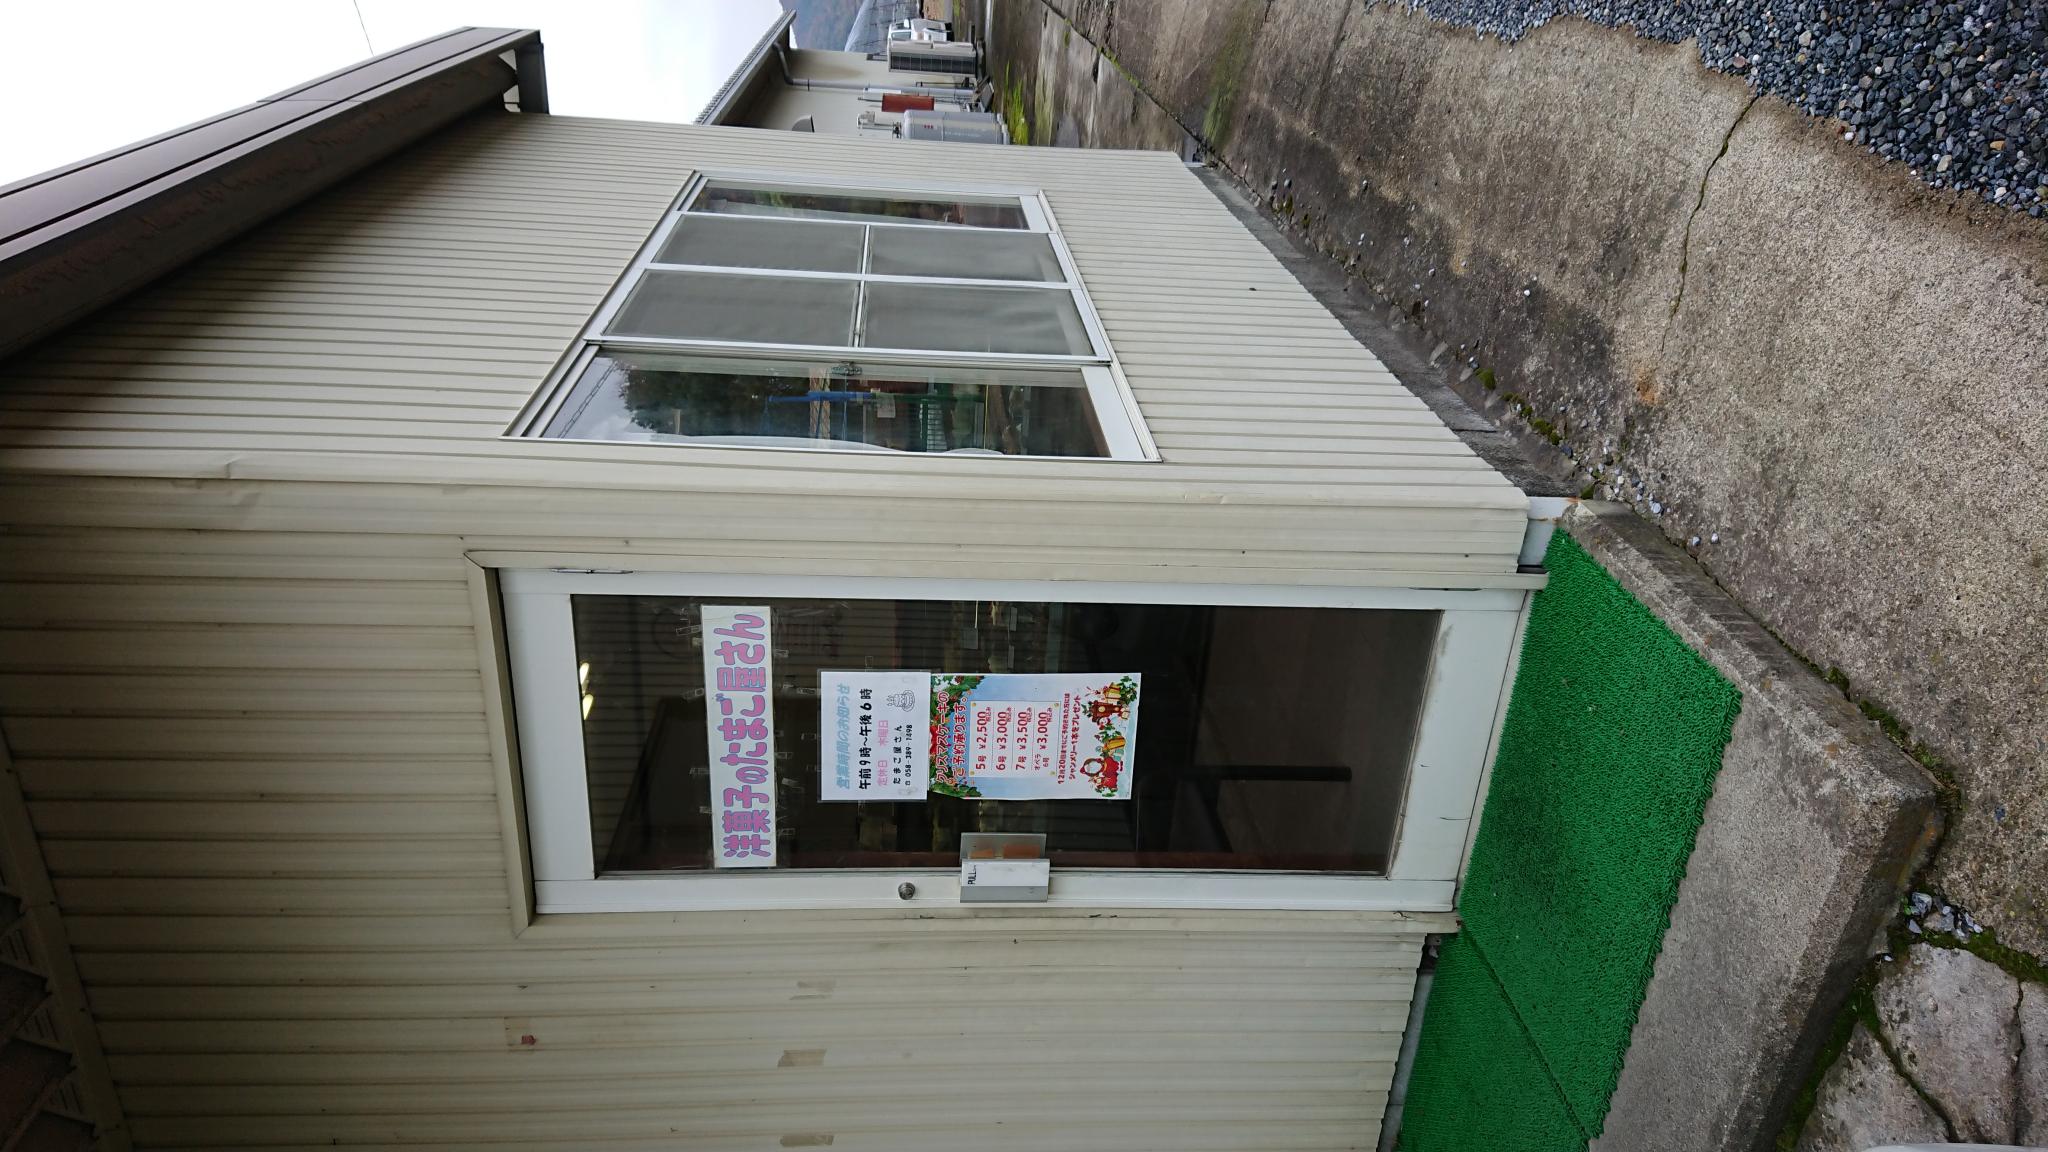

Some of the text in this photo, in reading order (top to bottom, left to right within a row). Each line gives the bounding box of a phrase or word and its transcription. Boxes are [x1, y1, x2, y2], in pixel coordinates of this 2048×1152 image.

[714, 613, 772, 858] 洋菓子のたまご屋さん
[836, 684, 850, 789] 営業時間のお知らせ
[936, 691, 949, 783] クリスマスケーキの
[953, 696, 967, 777] ご予約承ります。
[893, 725, 902, 784] たまご屋さん
[976, 755, 987, 770] 5号
[996, 756, 1007, 770] 6号
[1016, 755, 1027, 770] 7号
[1043, 757, 1049, 768] 6号
[878, 760, 888, 786] 定休日
[968, 872, 976, 885] PULL
